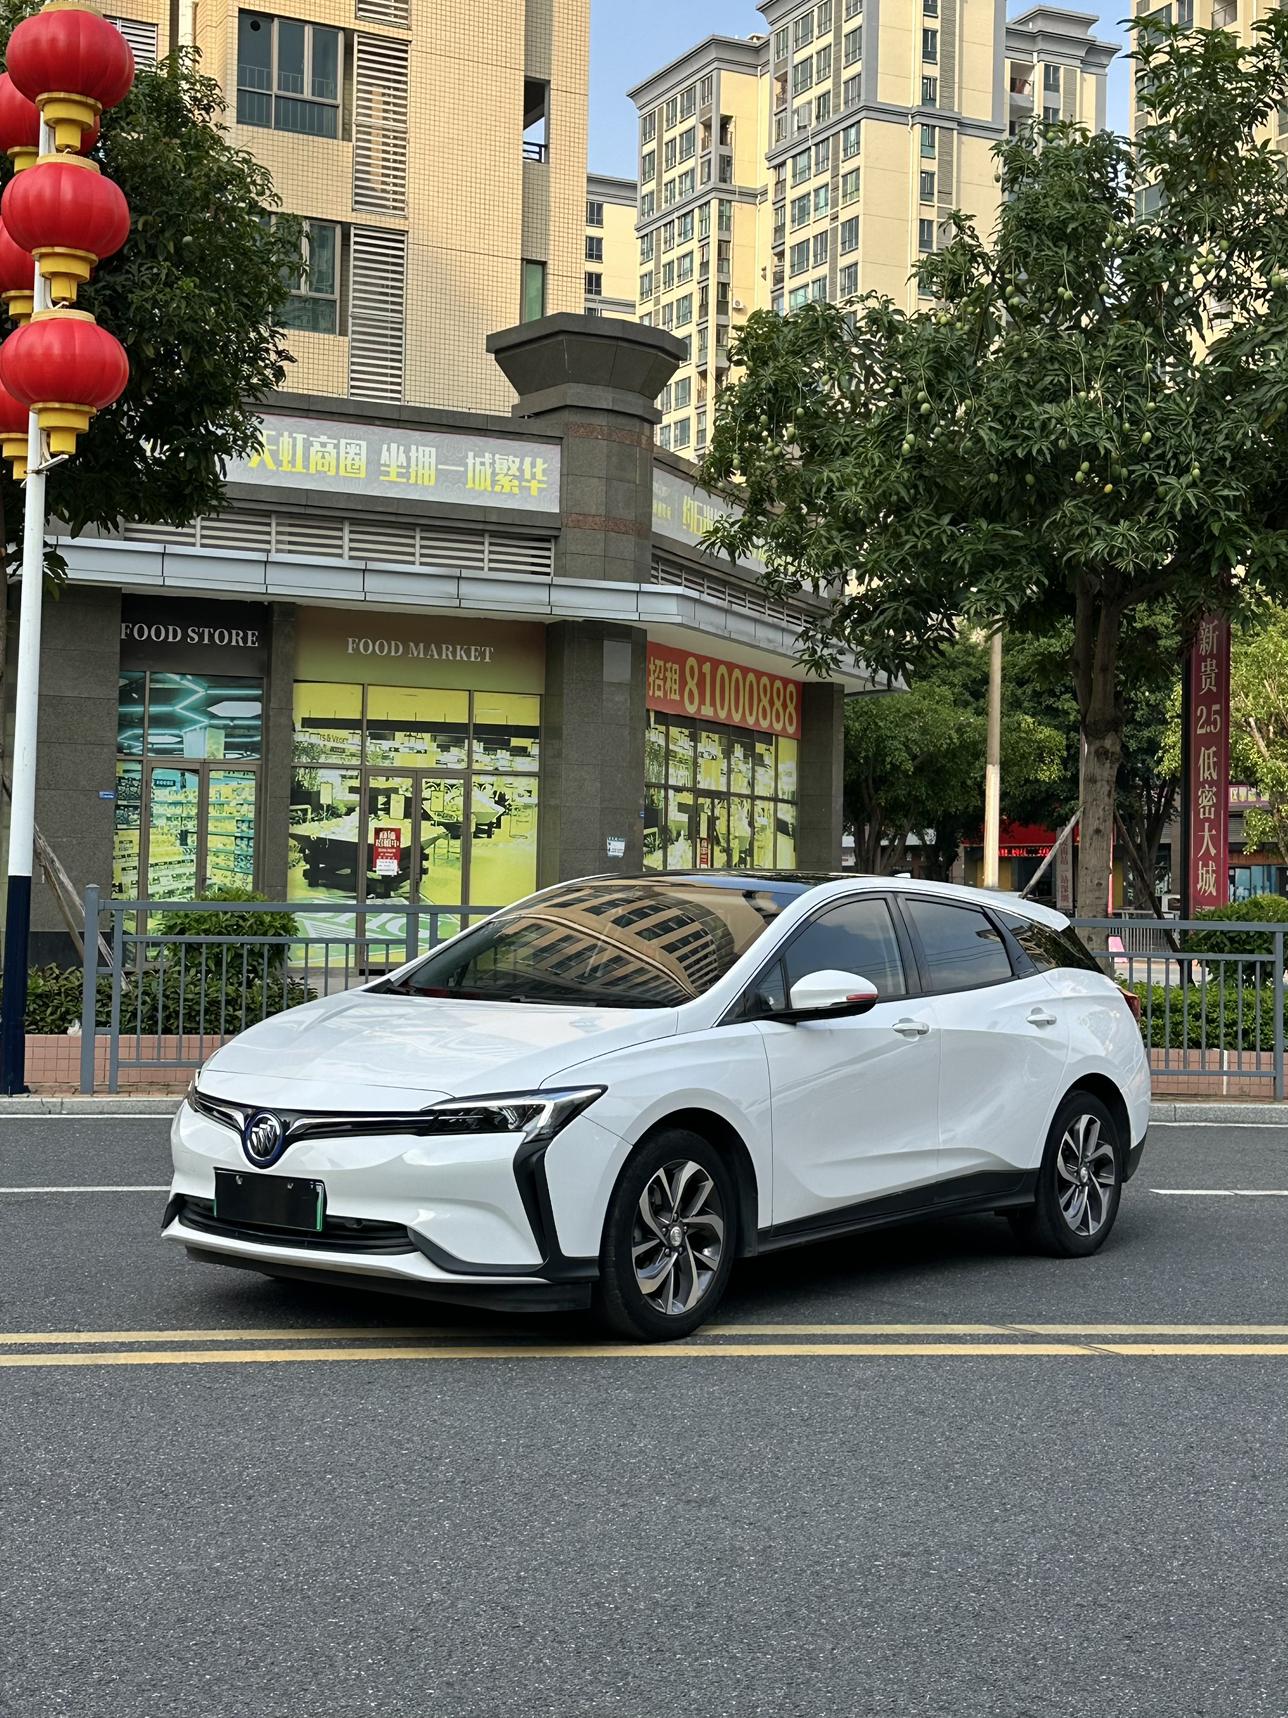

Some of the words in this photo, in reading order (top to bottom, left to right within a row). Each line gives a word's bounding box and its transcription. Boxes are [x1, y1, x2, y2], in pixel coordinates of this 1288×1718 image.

[248, 430, 367, 479] 天虹商圈
[379, 442, 548, 496] 坐拥一城繁华
[120, 622, 182, 642] FOOD
[187, 626, 259, 647] STORE
[347, 637, 403, 657] FOOD
[408, 641, 494, 663] MARKET
[648, 656, 680, 701] 招租
[683, 656, 798, 735] 81000888
